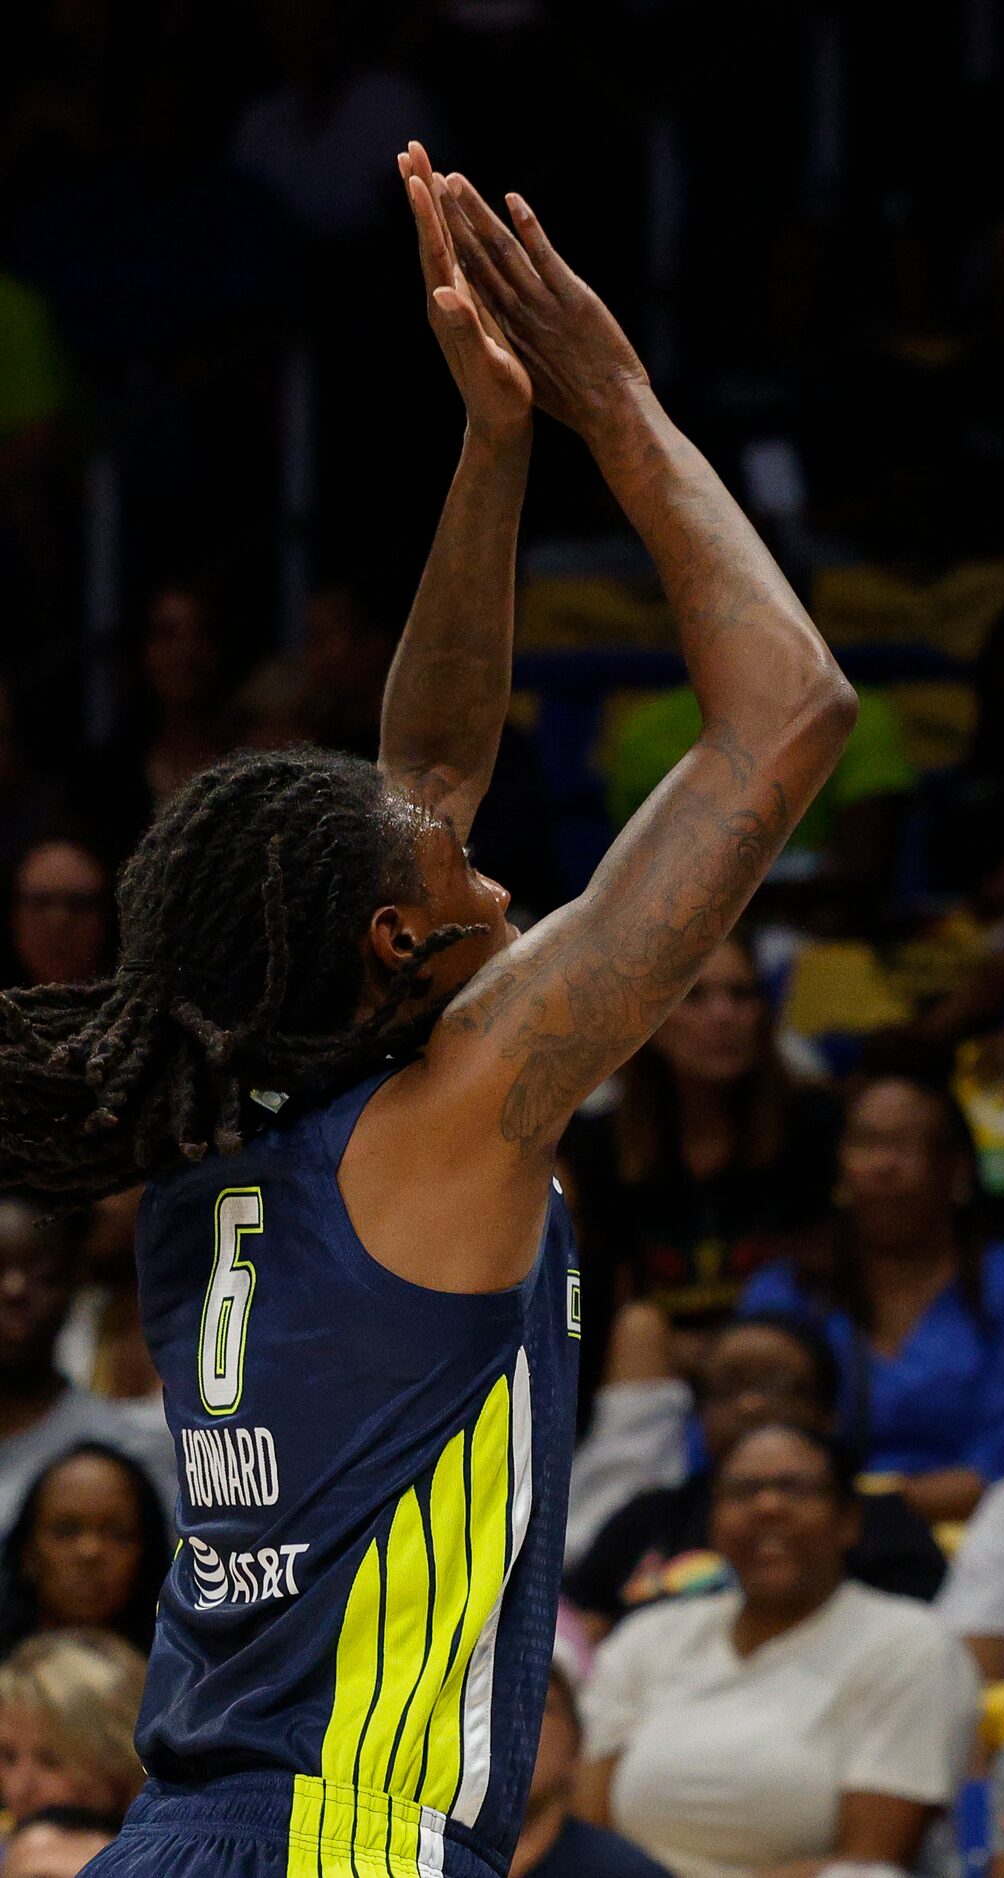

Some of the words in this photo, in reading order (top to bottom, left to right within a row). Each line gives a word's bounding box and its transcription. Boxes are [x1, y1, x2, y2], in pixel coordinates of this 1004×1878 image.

[198, 1186, 264, 1416] 6
[182, 1427, 280, 1507] HOWARD
[231, 1543, 310, 1604] AT&T
